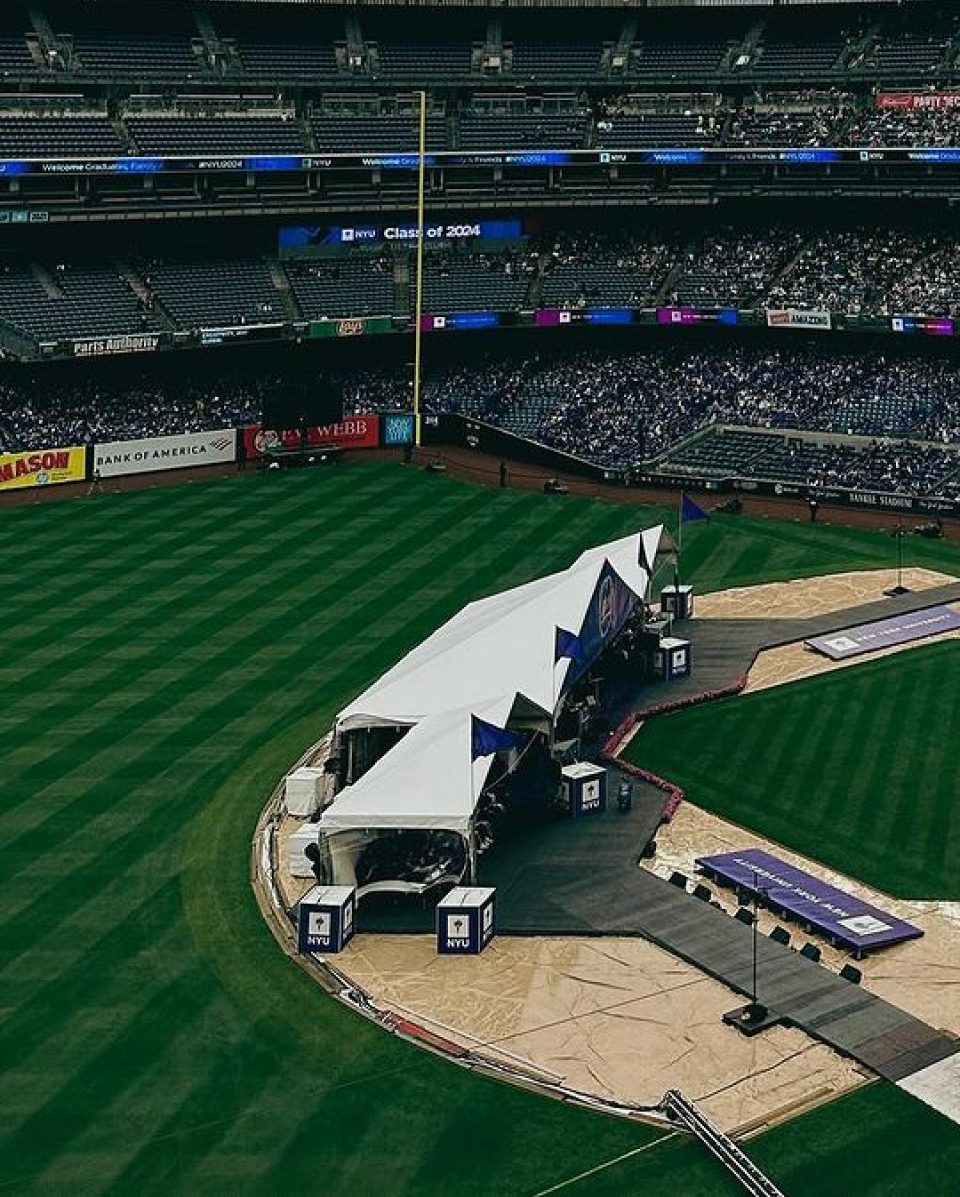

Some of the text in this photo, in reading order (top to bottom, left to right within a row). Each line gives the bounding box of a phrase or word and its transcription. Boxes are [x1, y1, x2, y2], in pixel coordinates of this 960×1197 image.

[611, 153, 626, 161] NYU
[43, 163, 84, 172] Welcome
[199, 160, 242, 169] #NYU2024
[313, 159, 331, 167] NYU
[355, 229, 376, 238] NYU
[426, 225, 443, 237] of
[446, 224, 481, 237] 2024
[75, 341, 104, 353] Parts
[107, 337, 159, 350] Authority
[318, 419, 367, 437] WEBB
[97, 445, 207, 466] BANK OF AMERICA
[0, 452, 69, 483] MASON
[307, 936, 330, 947] NYU
[446, 938, 470, 948] NYU
